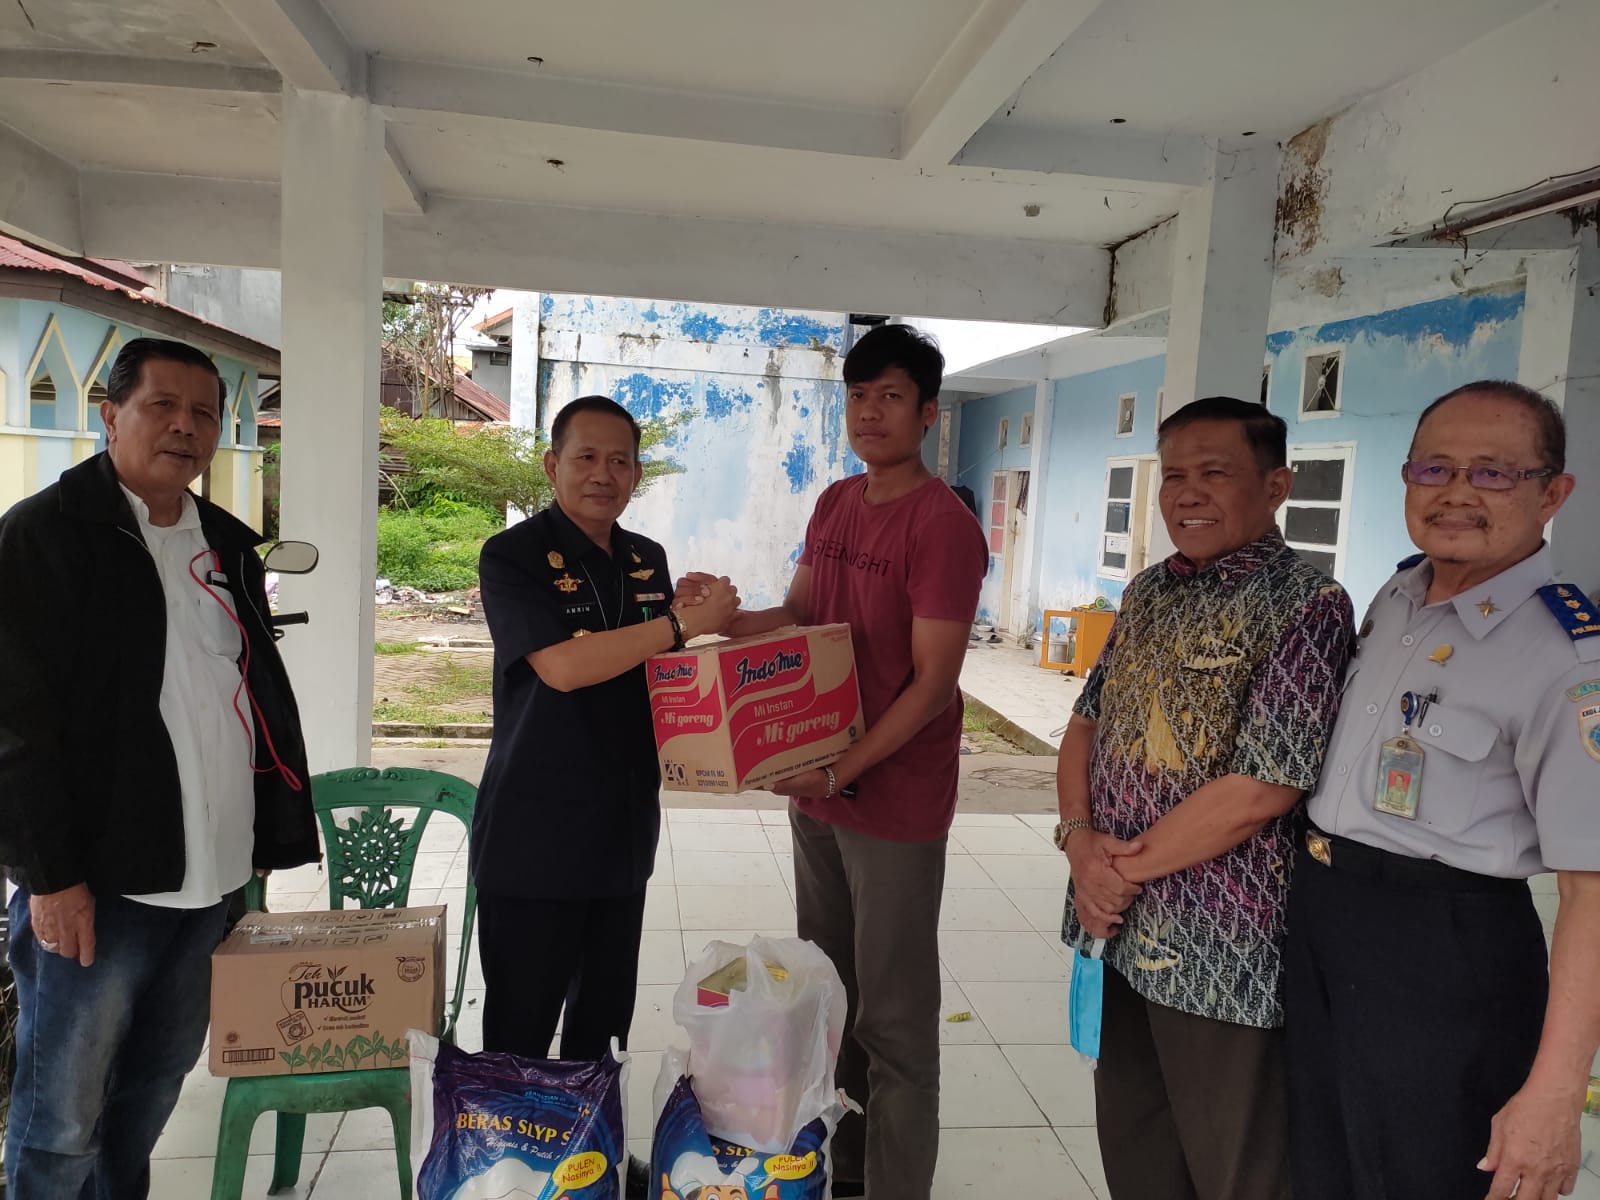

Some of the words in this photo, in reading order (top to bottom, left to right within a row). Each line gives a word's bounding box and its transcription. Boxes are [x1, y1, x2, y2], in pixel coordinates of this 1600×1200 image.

[661, 695, 668, 704] Mi
[668, 695, 686, 703] Instan
[754, 704, 766, 718] Mi
[766, 698, 794, 716] Instan
[660, 711, 676, 725] Mi
[678, 713, 714, 727] goreng
[756, 721, 784, 747] Mi
[788, 711, 841, 744] goreng
[288, 963, 323, 982] Teh
[294, 973, 375, 1010] pucuk
[308, 996, 369, 1012] HARUM
[456, 1112, 513, 1131] BERAS
[517, 1119, 558, 1143] SLYP
[568, 1157, 595, 1172] PULEN
[562, 1168, 594, 1183] Nasinya
